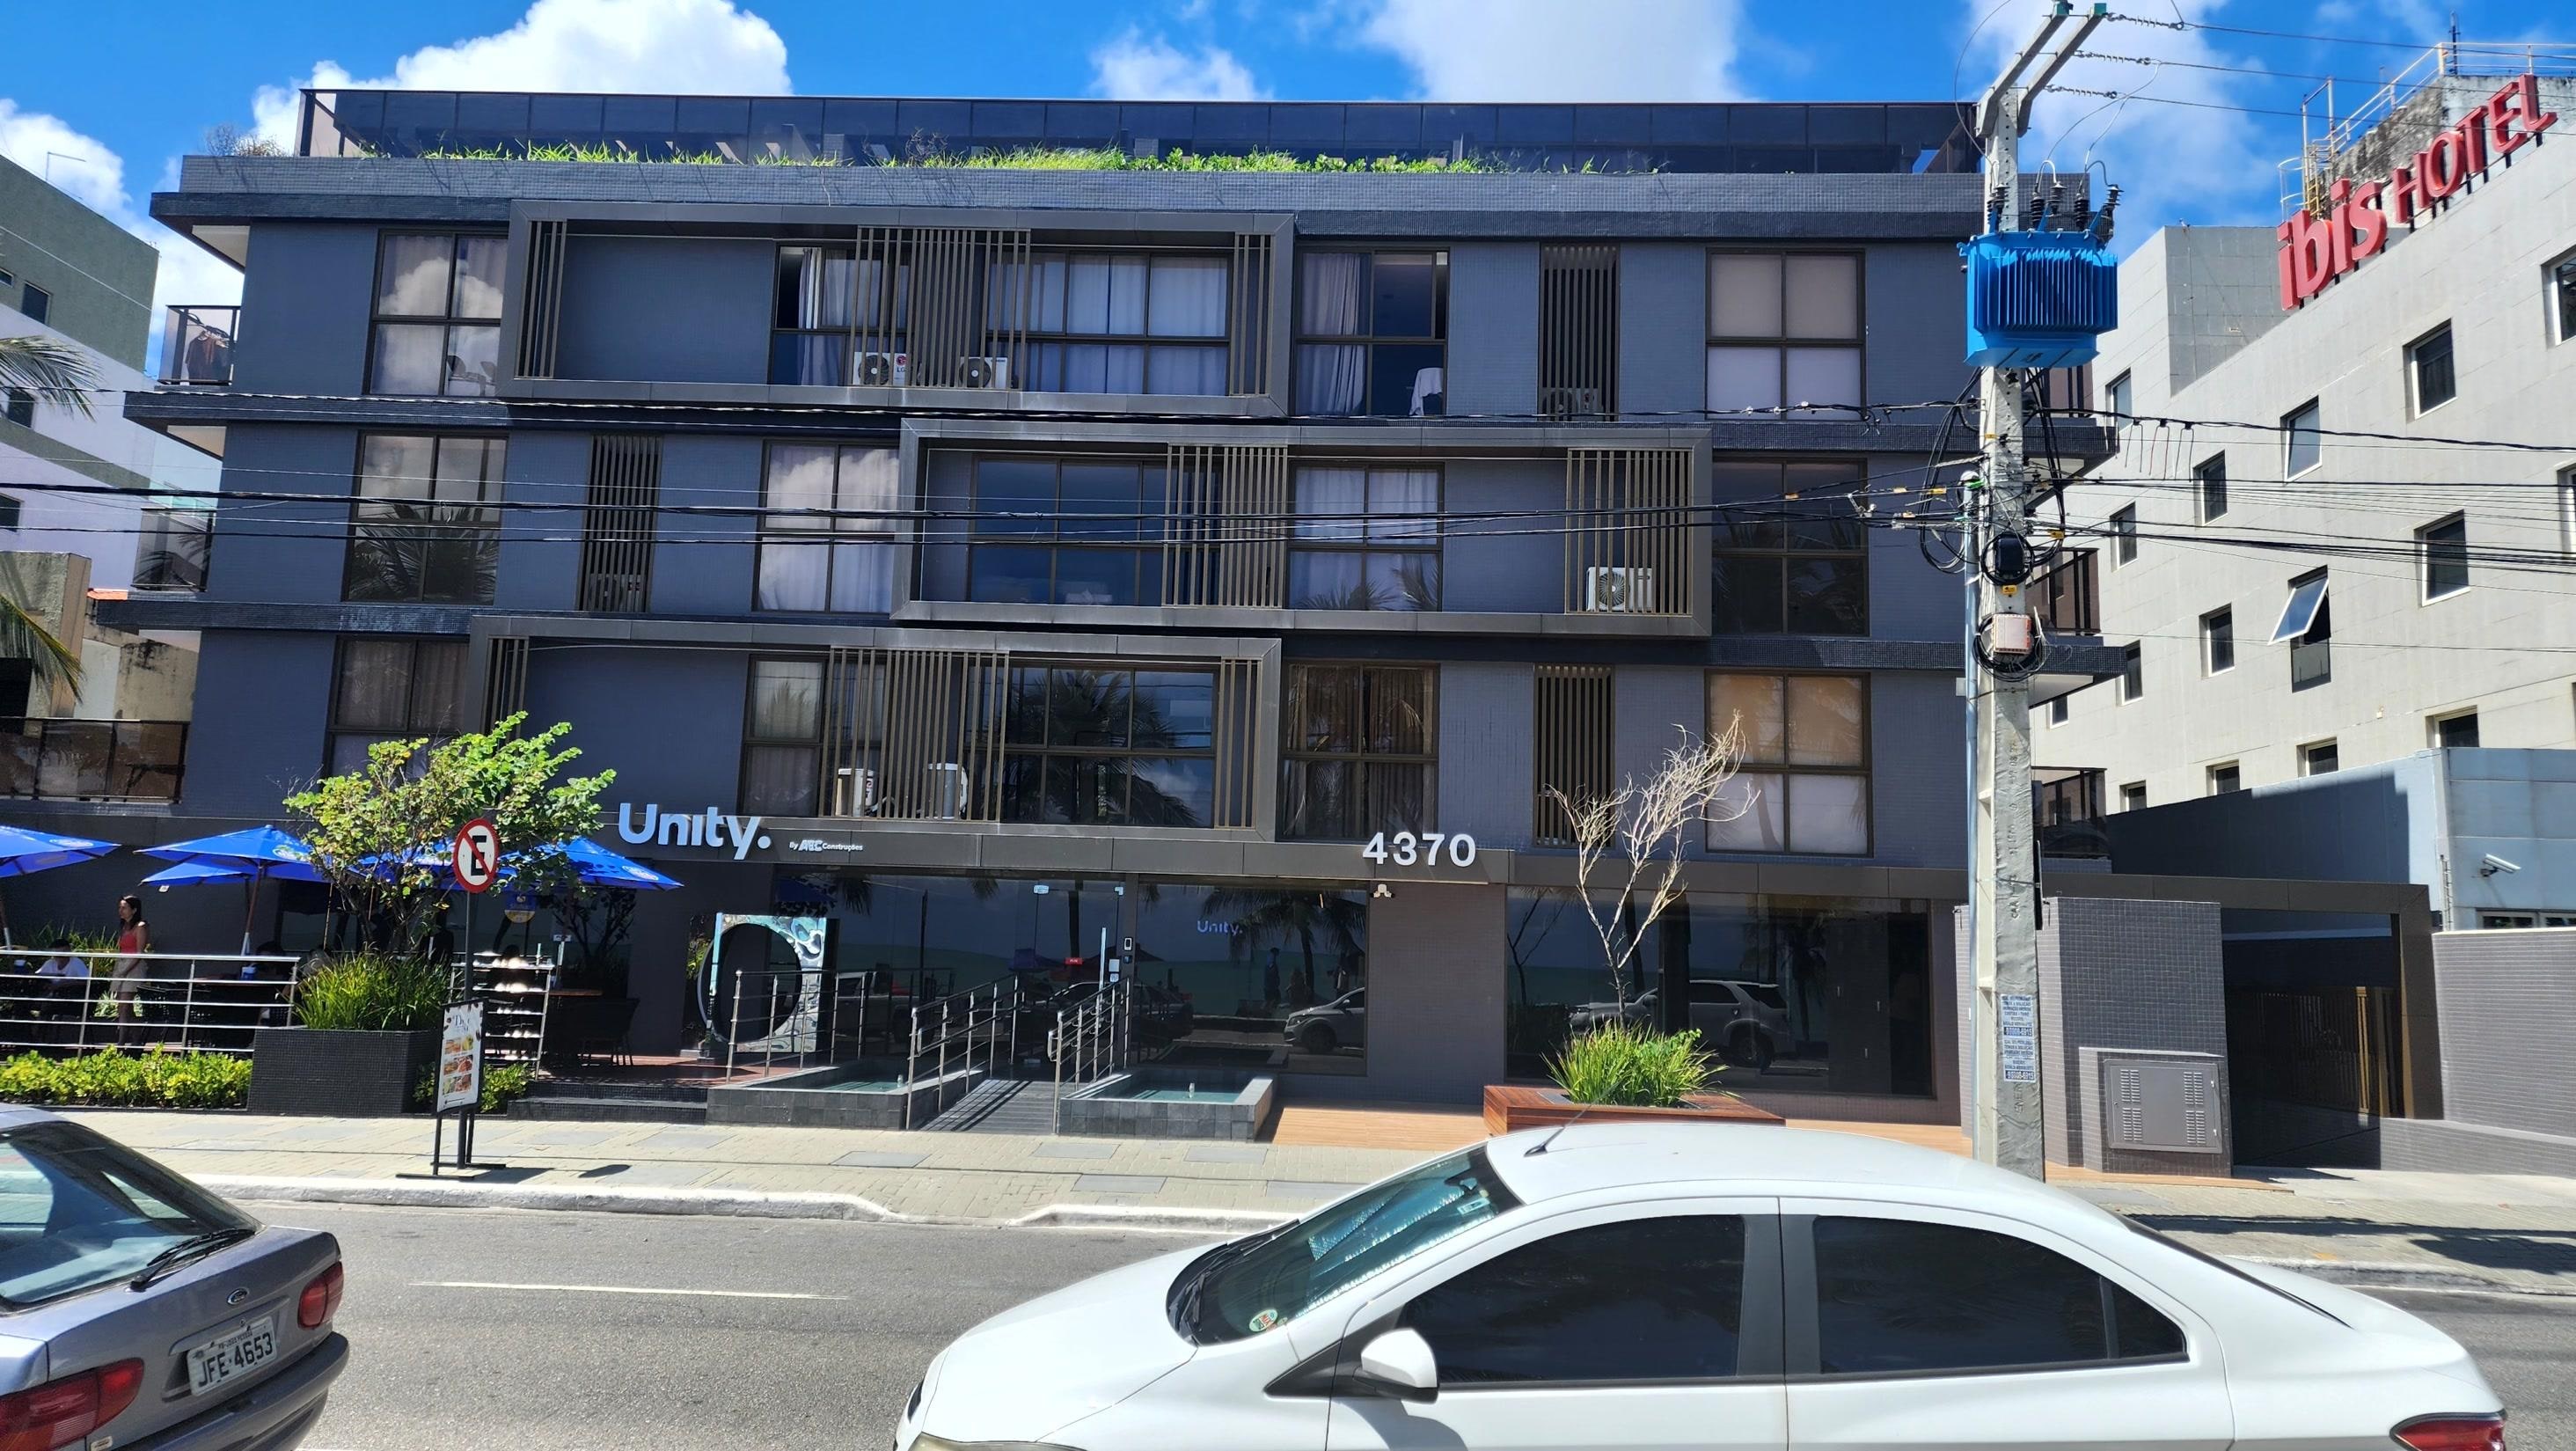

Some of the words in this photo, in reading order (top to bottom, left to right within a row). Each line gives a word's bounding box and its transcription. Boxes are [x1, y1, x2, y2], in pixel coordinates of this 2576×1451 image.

[2276, 178, 2388, 311] ibis
[2392, 73, 2558, 224] HOTEL
[618, 802, 772, 861] Unity.
[789, 841, 799, 850] By
[822, 843, 863, 853] Construções
[1362, 831, 1476, 868] 4370
[471, 835, 487, 876] E
[1197, 920, 1243, 936] Unity.
